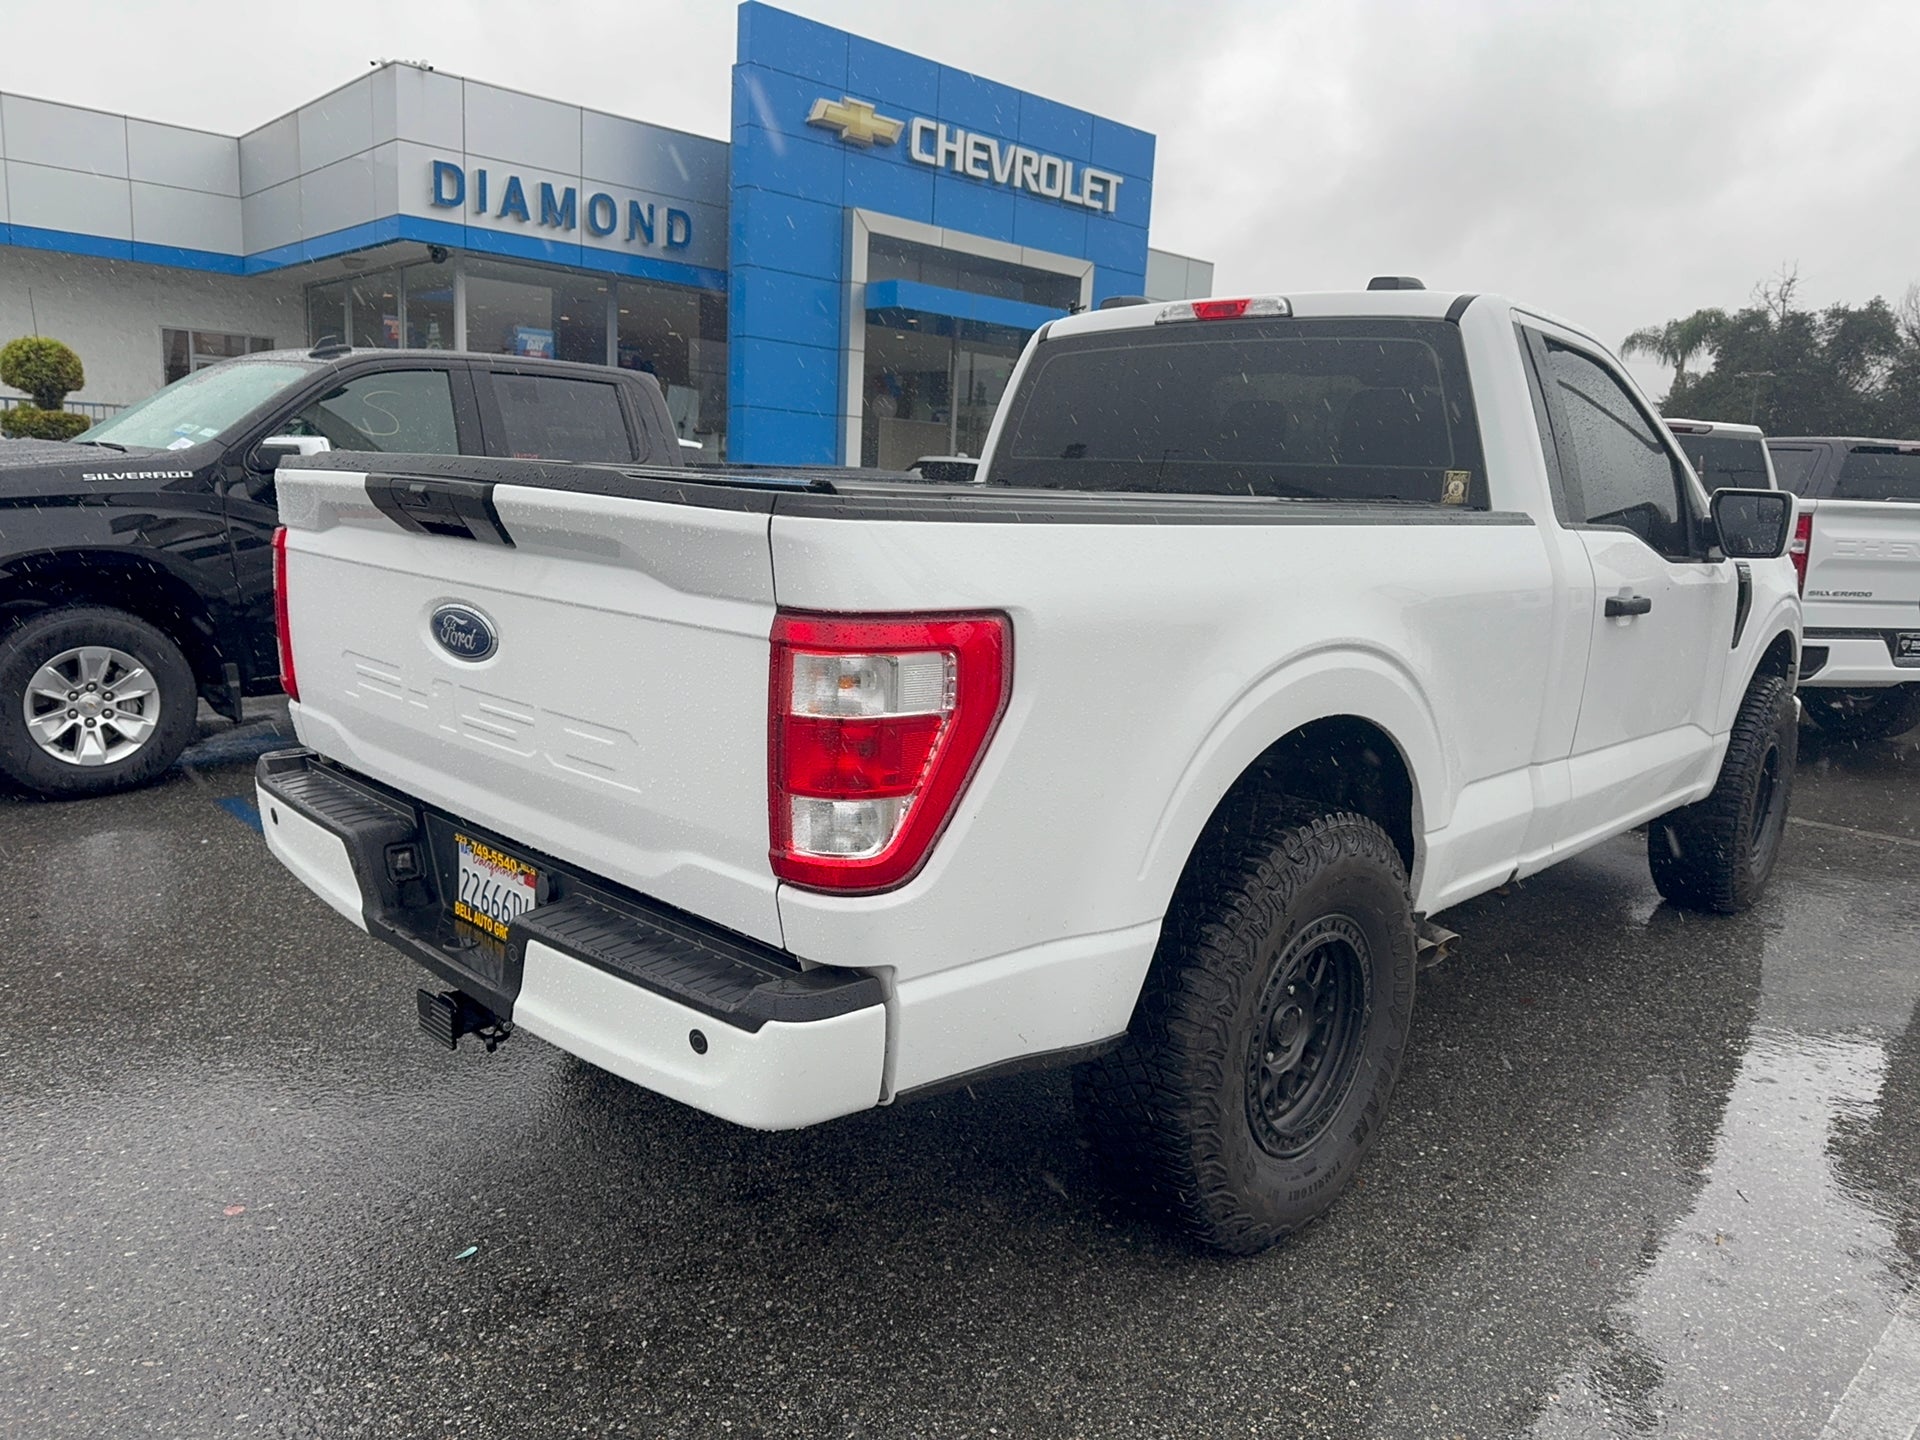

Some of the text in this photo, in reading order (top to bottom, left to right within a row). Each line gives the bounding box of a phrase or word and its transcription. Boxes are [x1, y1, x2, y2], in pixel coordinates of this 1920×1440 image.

[911, 116, 1124, 213] CHEVROLET
[431, 160, 692, 250] DIAMOND
[82, 470, 194, 482] SILVERADO
[1832, 540, 1920, 558] CHE
[1808, 590, 1873, 598] SILVERADO
[440, 614, 477, 650] Ford
[341, 649, 643, 793] F-150
[471, 841, 518, 873] 749-5540
[454, 901, 472, 922] BELL
[473, 911, 493, 932] AUTO
